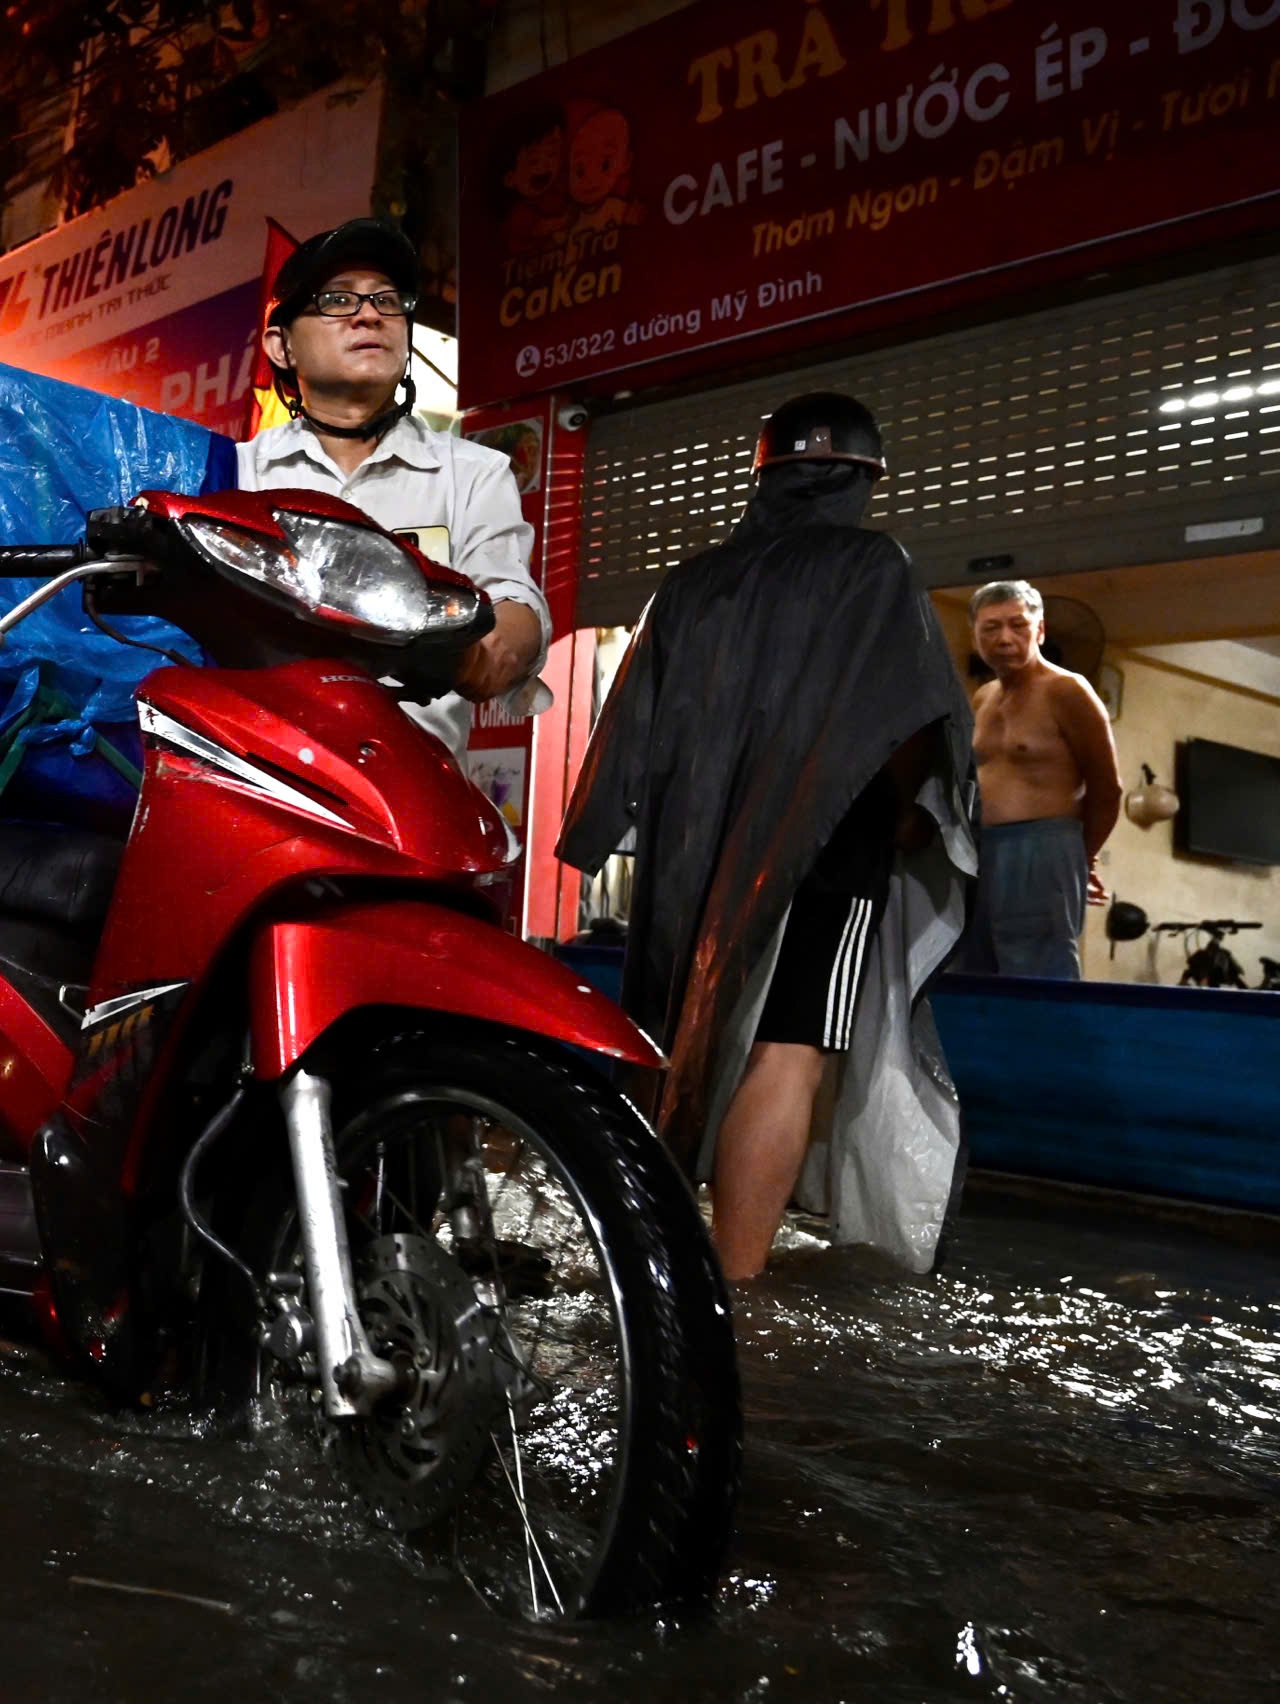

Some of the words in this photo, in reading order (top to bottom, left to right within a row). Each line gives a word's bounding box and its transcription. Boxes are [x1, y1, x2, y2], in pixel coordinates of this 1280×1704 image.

[663, 139, 783, 225] CAFE
[834, 62, 1010, 170] NƯỚC
[1035, 21, 1108, 103] ÉP
[846, 176, 937, 231] Ngon
[1082, 109, 1120, 161] Vị
[499, 263, 622, 328] CaKen
[543, 329, 616, 369] 53/322
[623, 307, 701, 347] đường
[711, 289, 748, 322] Mỹ
[757, 271, 823, 308] Đình
[144, 337, 160, 362] 2
